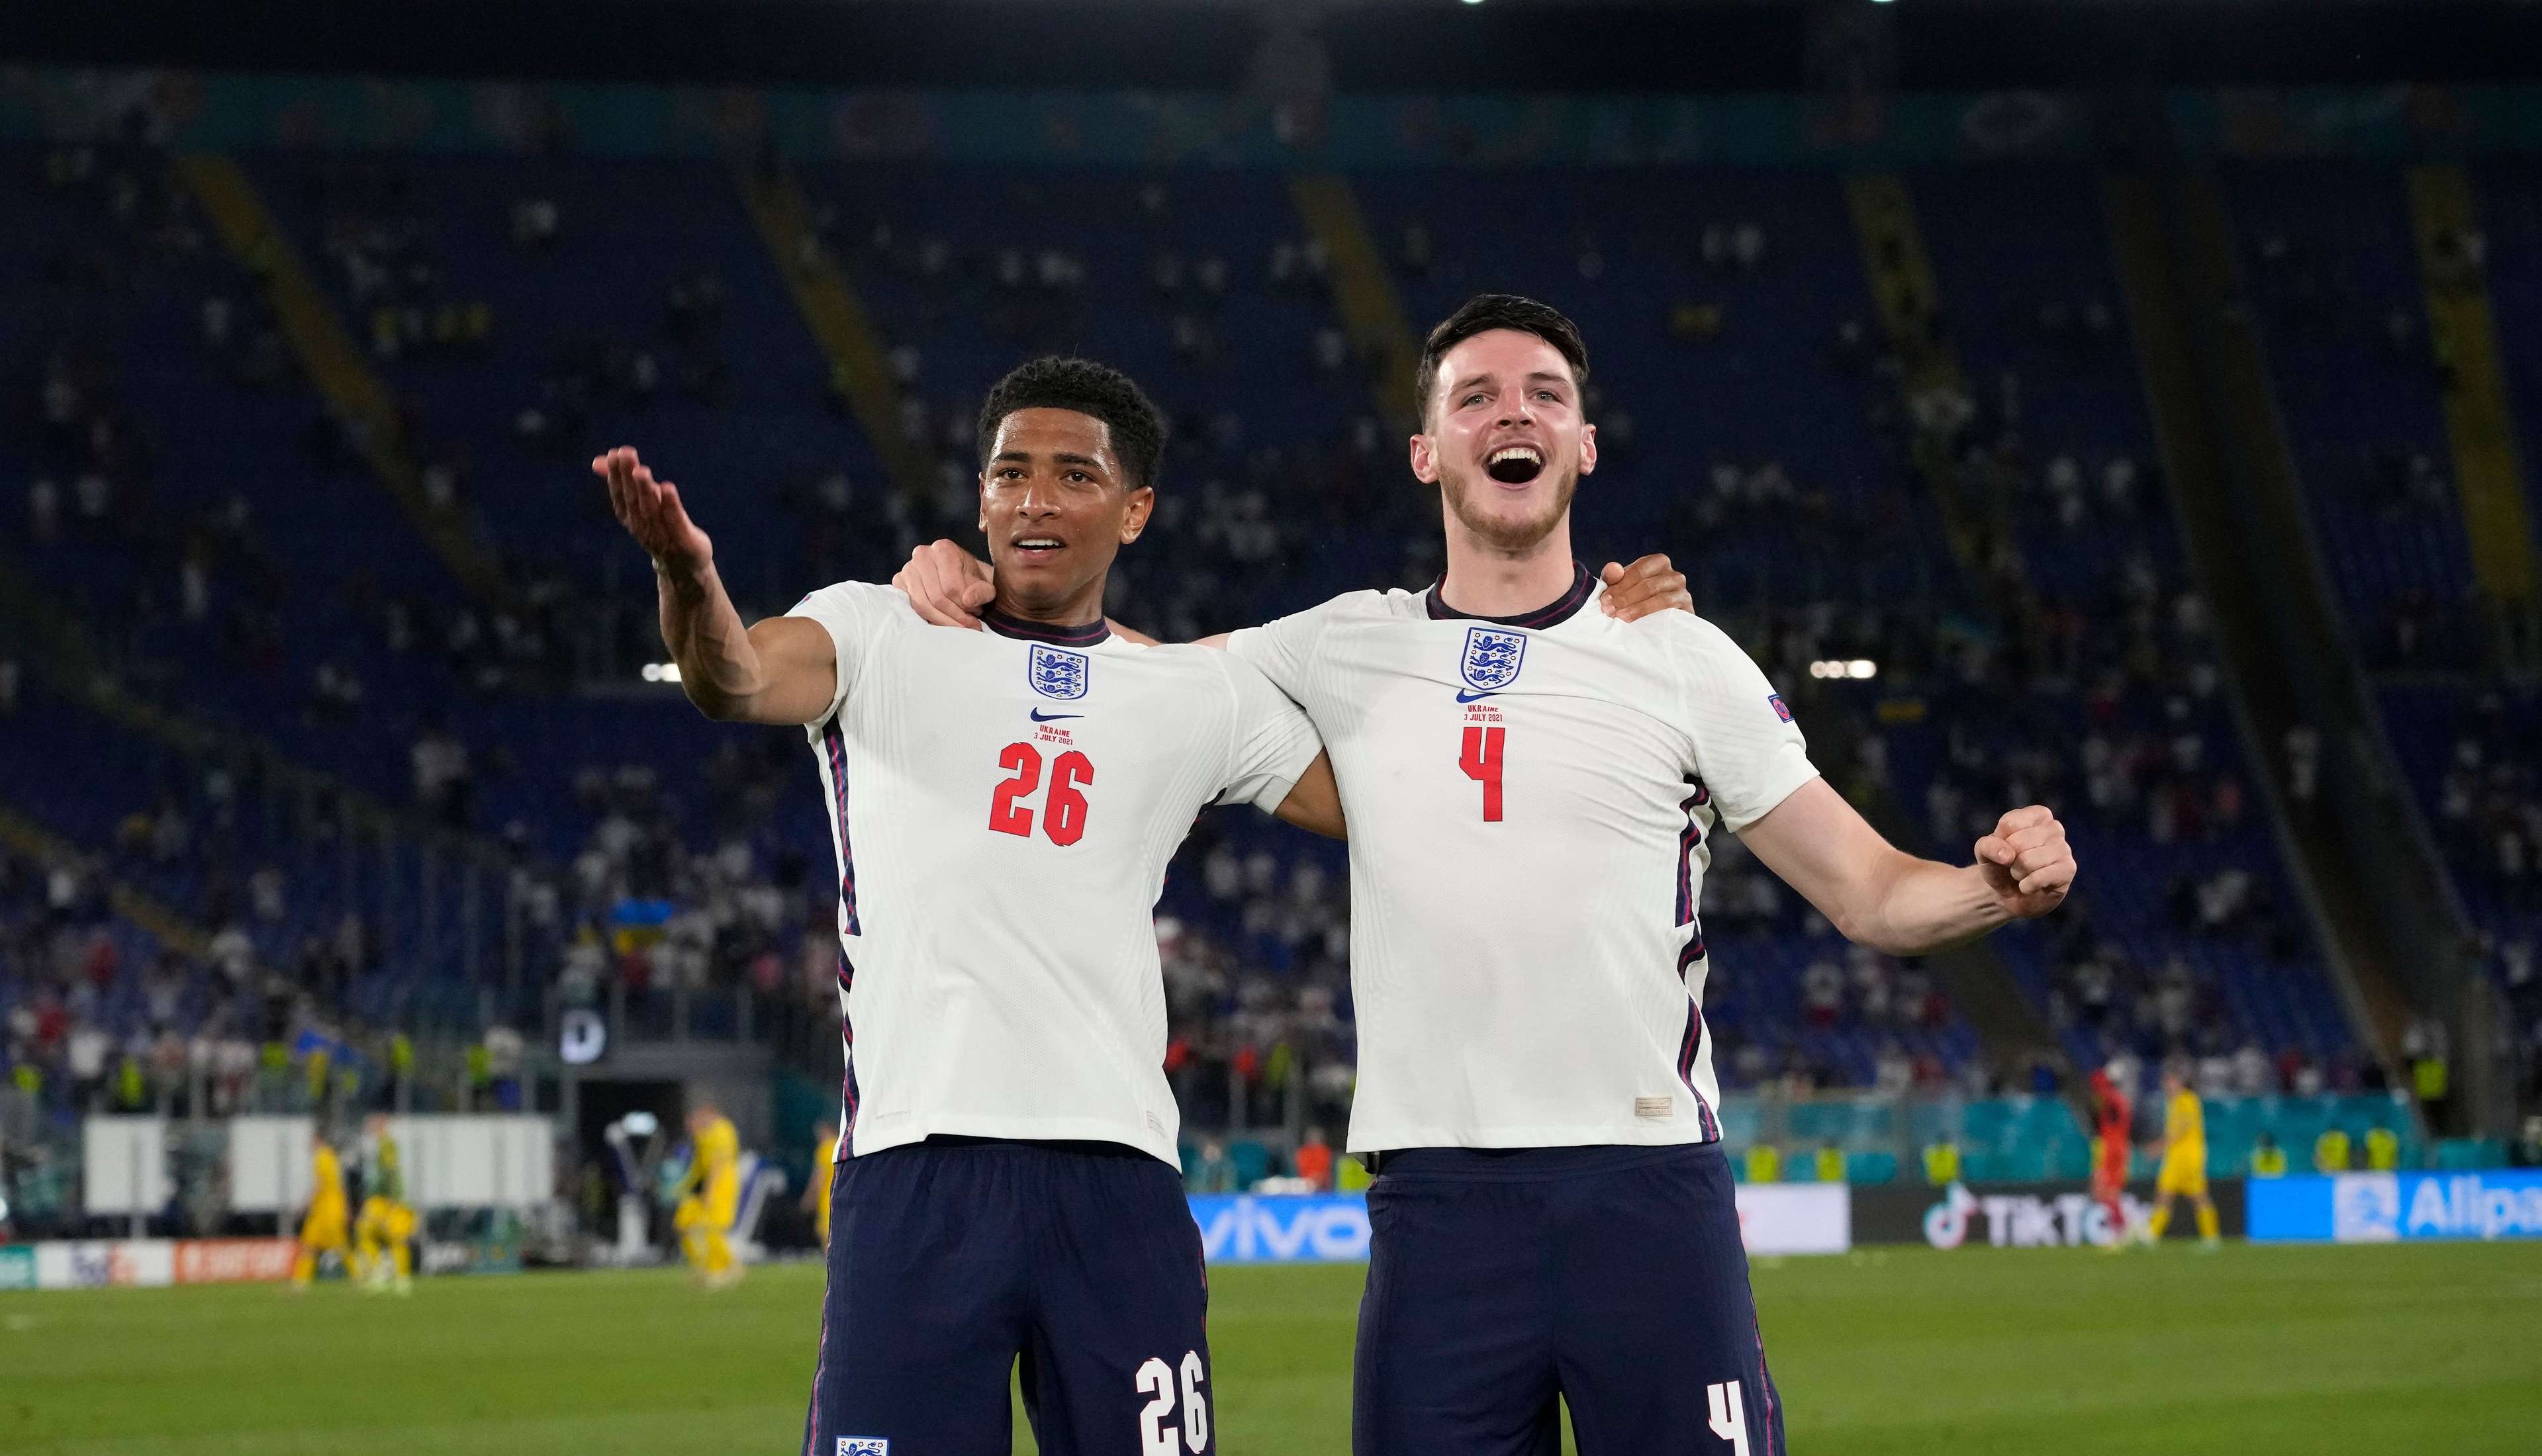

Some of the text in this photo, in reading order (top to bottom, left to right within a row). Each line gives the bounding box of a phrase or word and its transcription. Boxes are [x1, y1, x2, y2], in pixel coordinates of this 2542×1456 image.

[1039, 724, 1070, 737] UKRAINE
[1059, 737, 1073, 745] 2021
[988, 742, 1094, 846] 26
[1459, 727, 1505, 821] 4
[1135, 1349, 1209, 1456] 26
[1707, 1380, 1750, 1456] 4
